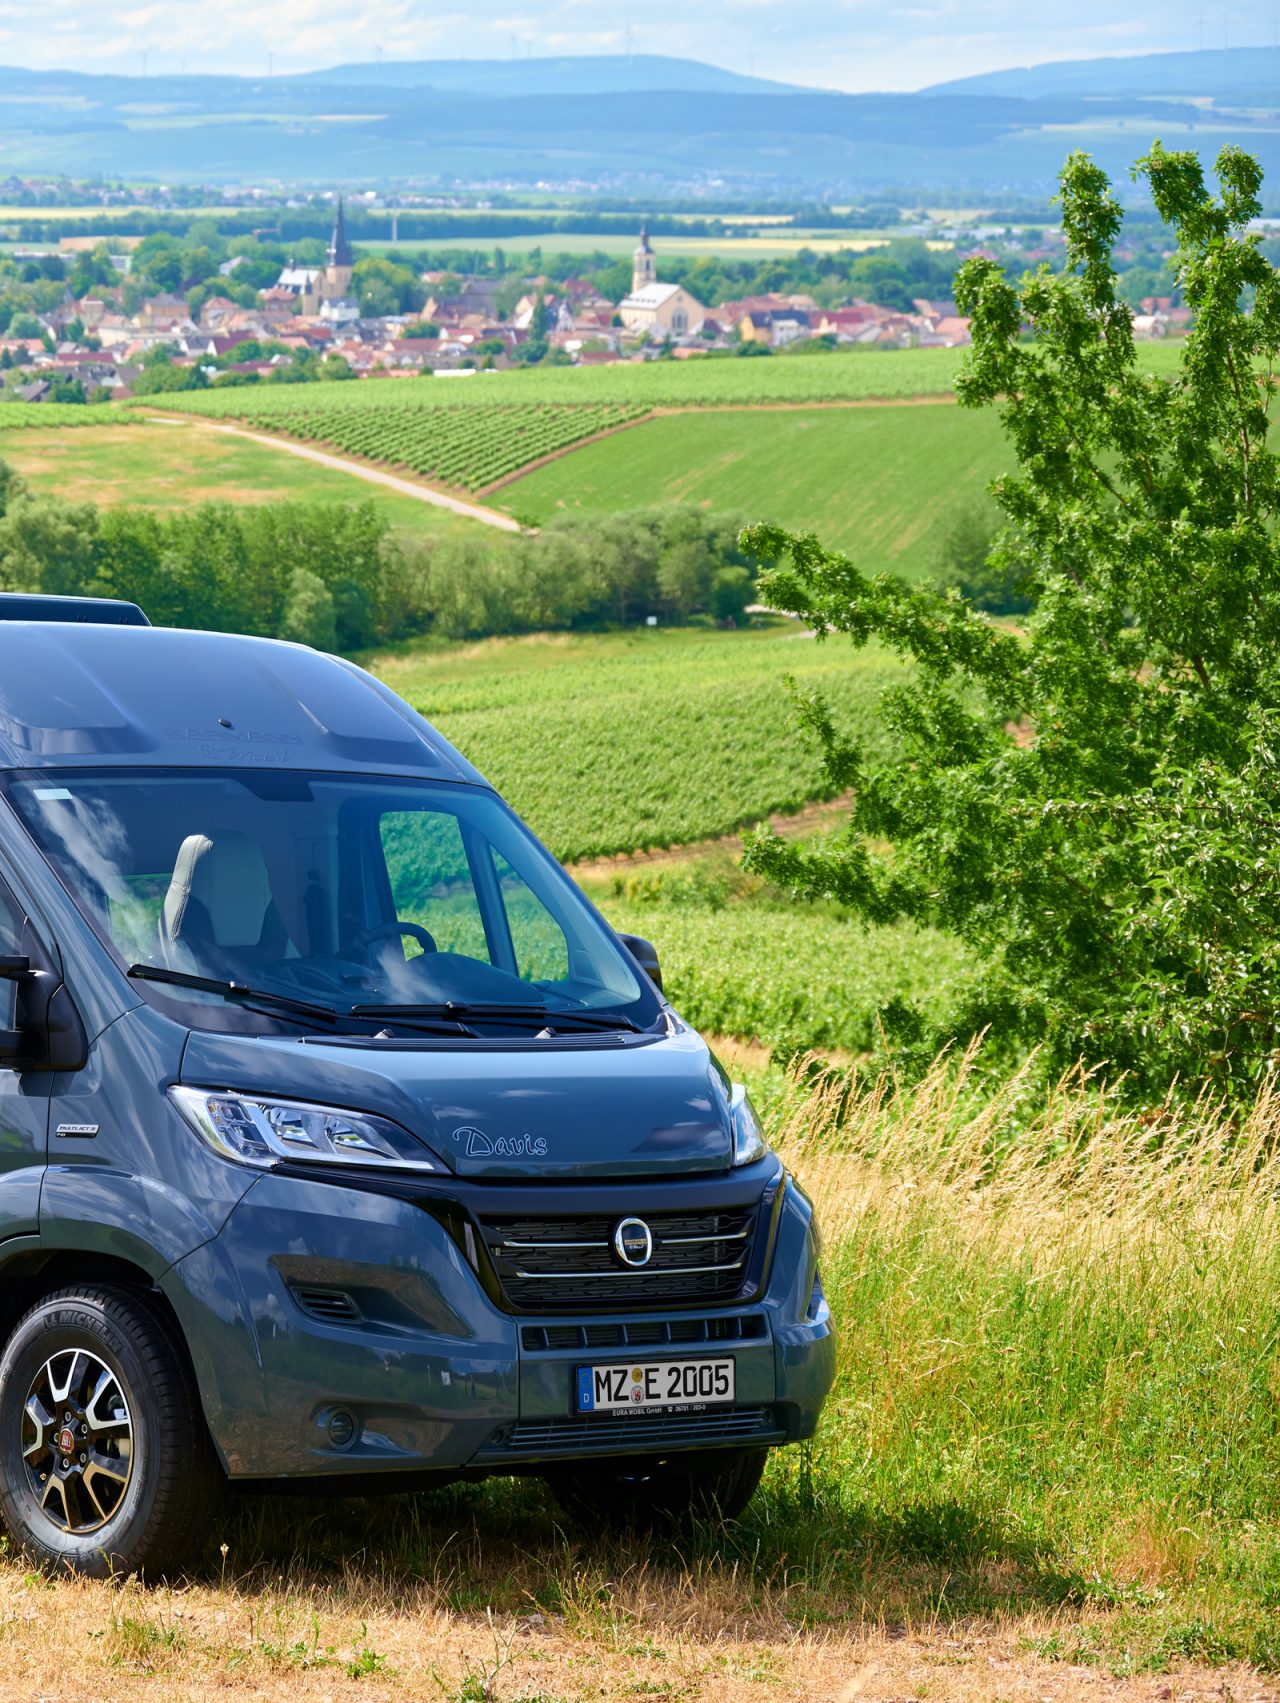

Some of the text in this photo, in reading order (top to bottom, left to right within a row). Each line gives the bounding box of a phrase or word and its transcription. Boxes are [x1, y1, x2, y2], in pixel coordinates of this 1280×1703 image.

[452, 1126, 548, 1156] Davis
[59, 1310, 122, 1353] MICHELIN
[583, 1364, 730, 1403] D MZ E 2005
[612, 1409, 628, 1417] EURA
[629, 1408, 645, 1416] MOBIL
[646, 1406, 662, 1415] GmbH
